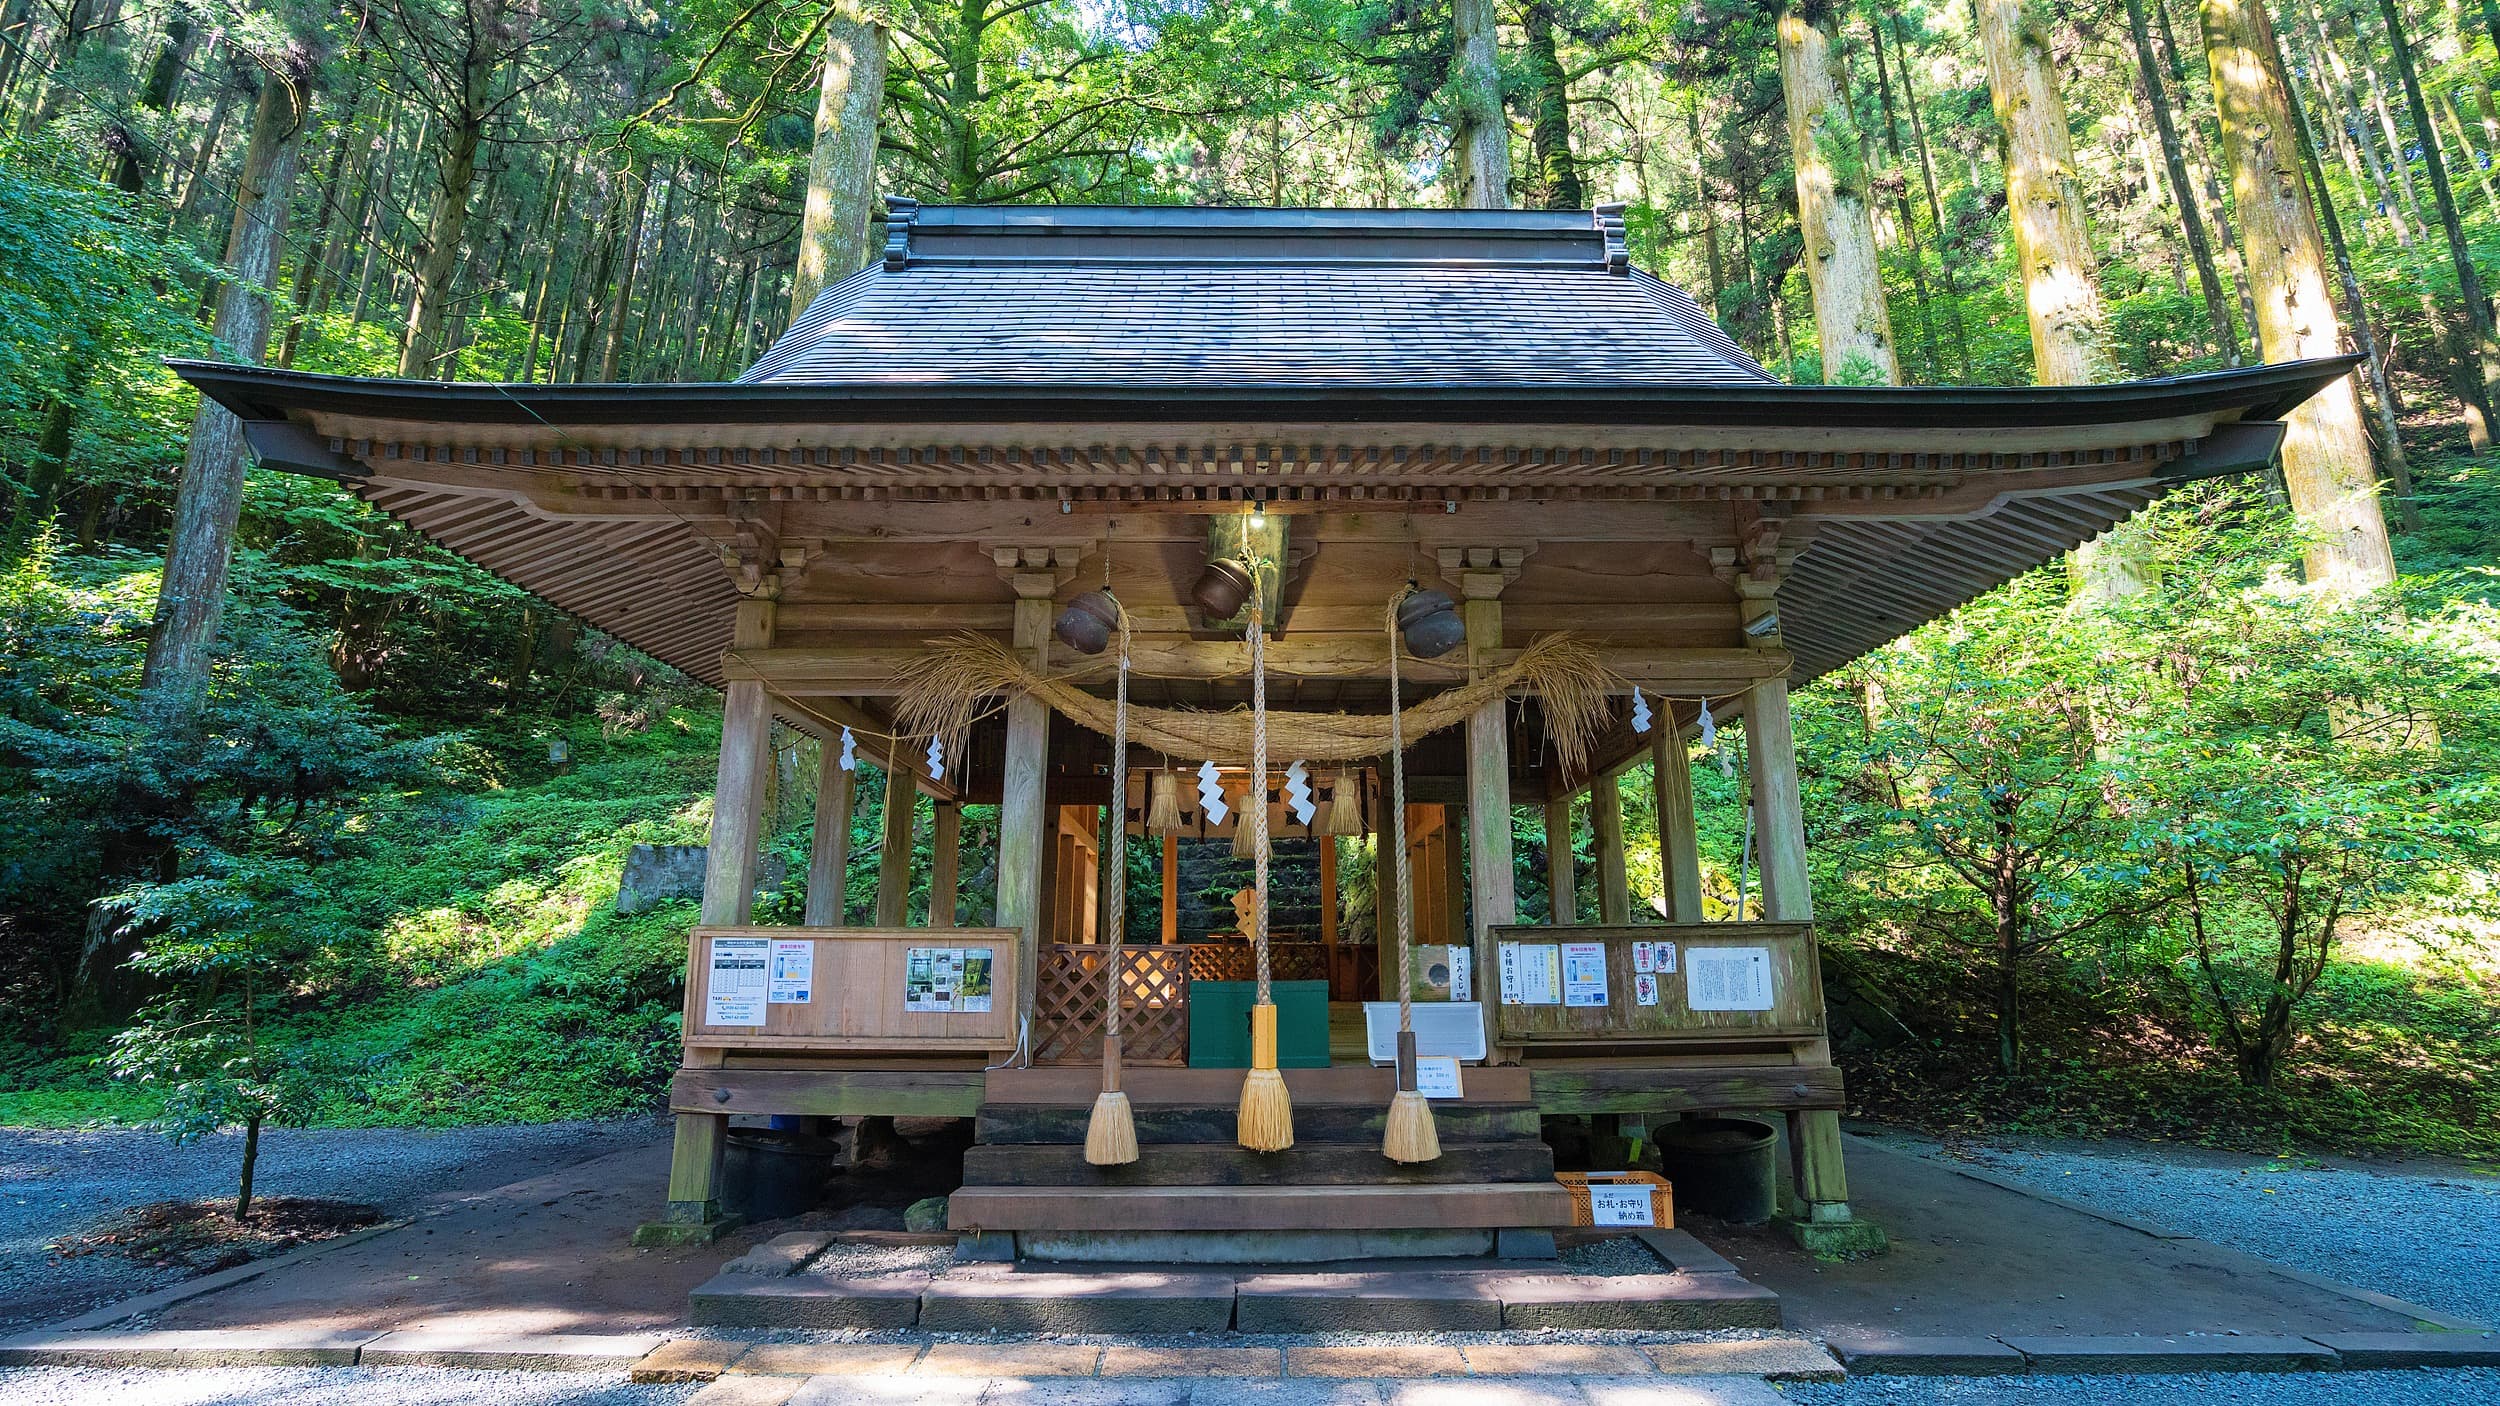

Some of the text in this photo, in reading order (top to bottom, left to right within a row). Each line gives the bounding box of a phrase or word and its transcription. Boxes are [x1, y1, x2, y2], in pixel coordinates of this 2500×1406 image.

[1456, 957, 1464, 990] おみくじ
[1505, 949, 1514, 991] 各種お守り
[1597, 1199, 1643, 1209] お札・お守り
[1618, 1210, 1645, 1220] 納め箱
